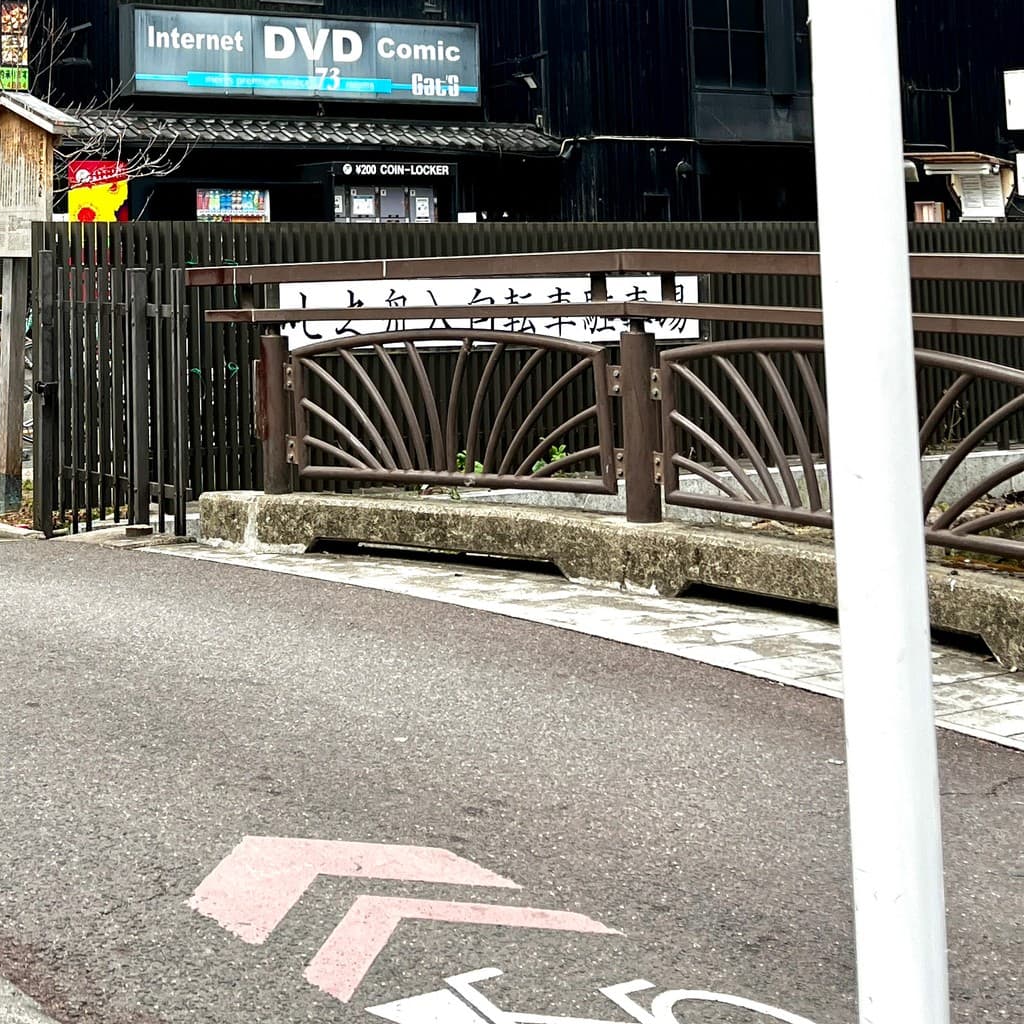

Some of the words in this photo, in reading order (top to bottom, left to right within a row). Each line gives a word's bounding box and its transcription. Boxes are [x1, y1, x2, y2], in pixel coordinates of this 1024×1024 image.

[147, 26, 244, 53] Internet
[263, 25, 363, 63] DVD
[377, 37, 461, 62] Comic
[314, 67, 340, 91] 73
[355, 164, 376, 175] ¥200
[380, 164, 449, 175] COIN-LOCKER
